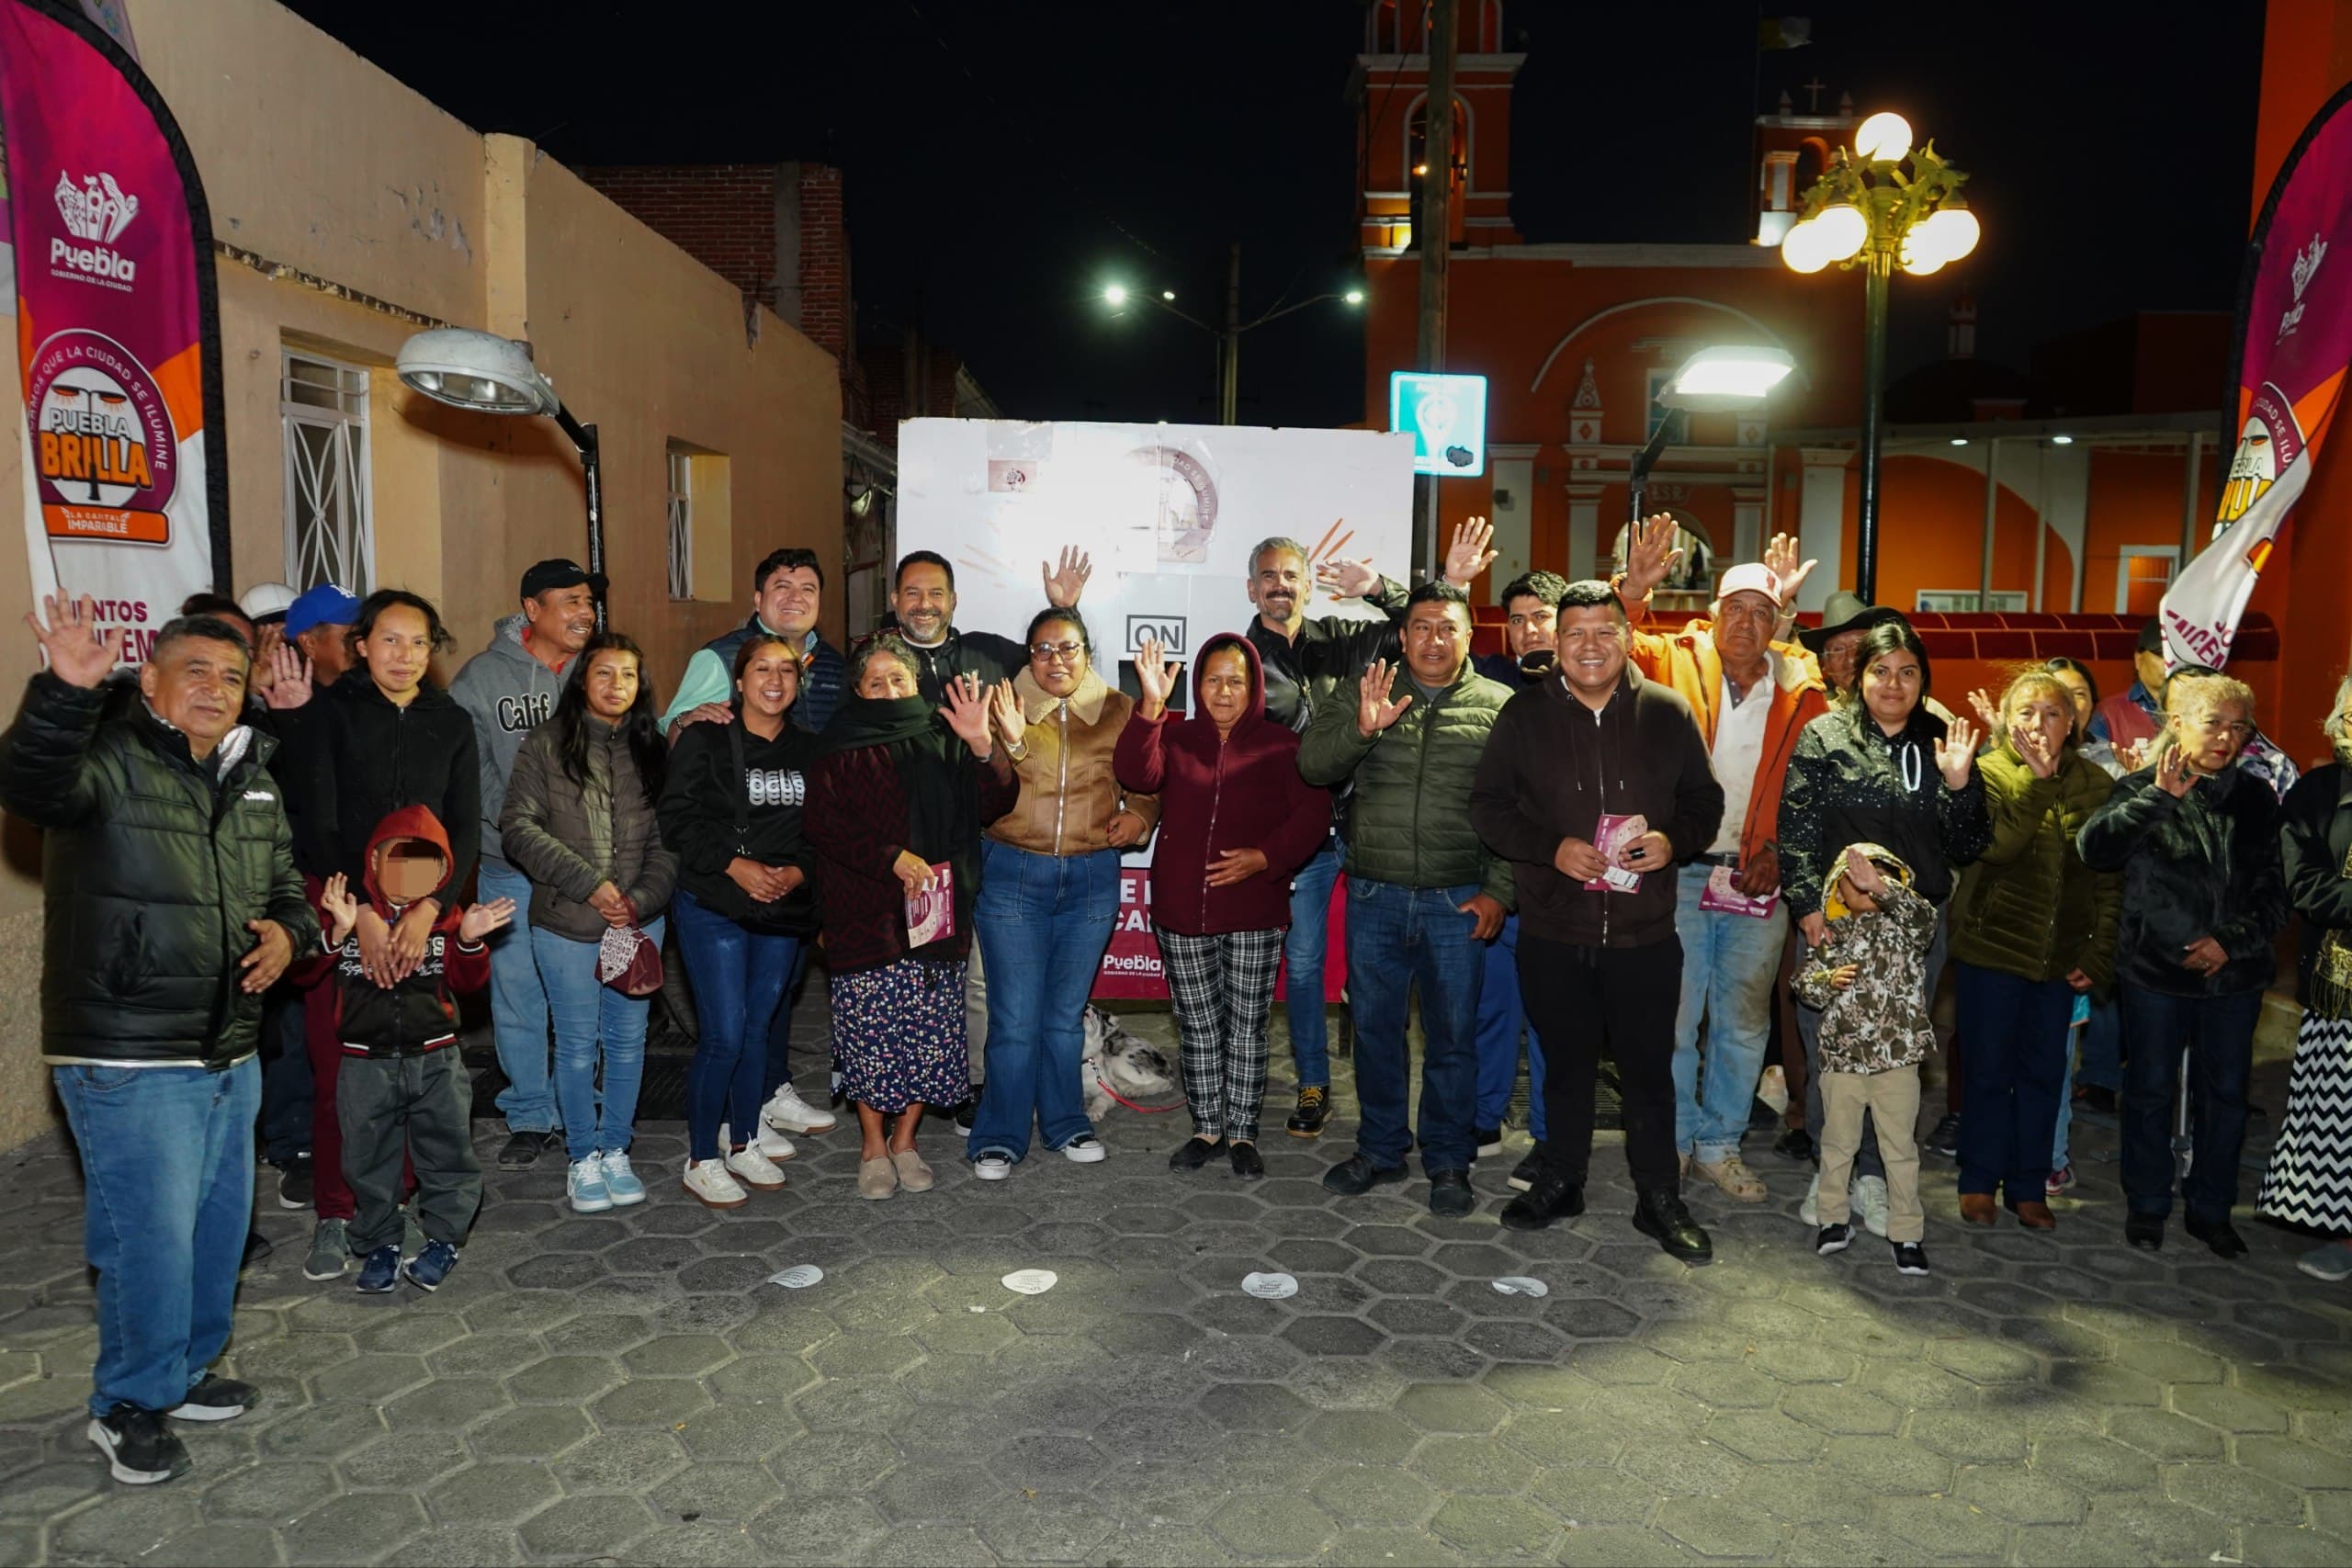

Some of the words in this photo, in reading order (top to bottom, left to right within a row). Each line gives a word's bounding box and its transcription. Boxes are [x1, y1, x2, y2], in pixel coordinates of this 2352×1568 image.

[51, 237, 135, 281] Puebla
[42, 351, 64, 375] QUE
[66, 345, 83, 359] LA
[85, 346, 132, 380] CIUDAD
[131, 381, 148, 400] SE
[144, 403, 168, 470] ILUMINE
[50, 408, 131, 440] PUEBLA
[2274, 420, 2286, 437] SE
[40, 429, 153, 489] BRILLA
[68, 519, 129, 534] IMPARABLE
[1135, 624, 1180, 650] ON
[1102, 954, 1161, 971] Puebla
